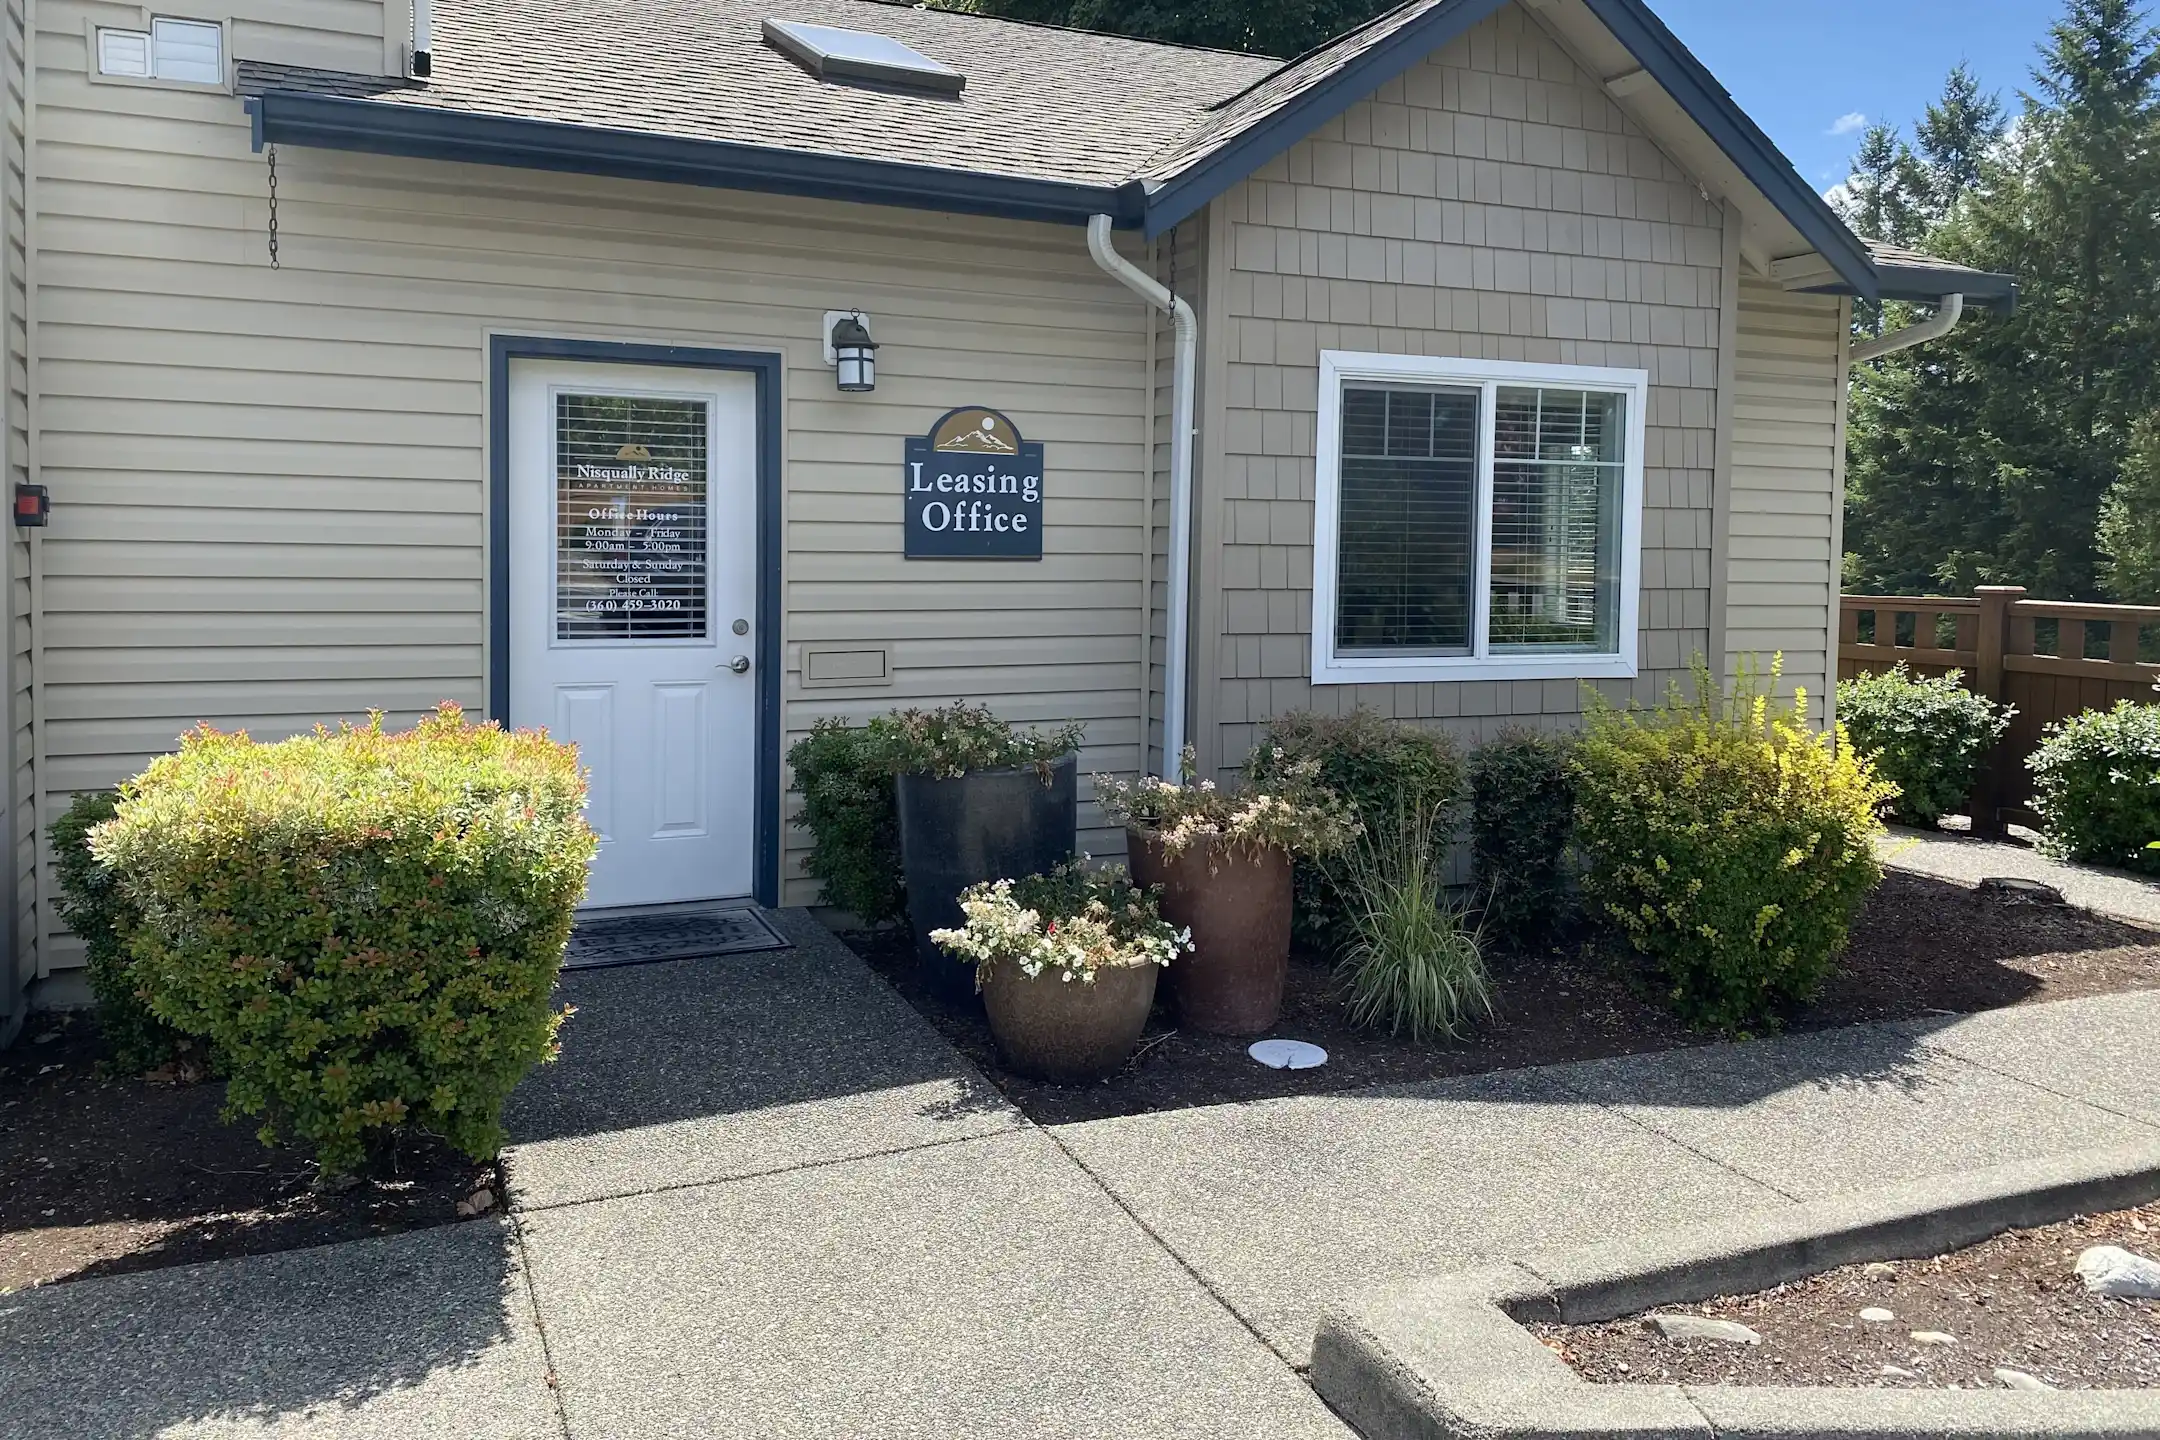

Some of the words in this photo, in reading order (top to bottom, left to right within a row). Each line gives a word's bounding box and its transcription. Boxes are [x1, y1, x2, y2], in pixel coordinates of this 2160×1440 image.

[576, 464, 645, 483] Nisqually
[647, 466, 690, 484] Ridge
[910, 462, 1039, 503] Leasing
[588, 507, 634, 520] Office
[635, 508, 679, 521] Hours
[922, 500, 1028, 532] Office
[585, 526, 632, 538] Monday
[650, 527, 681, 540] Friday
[585, 540, 625, 551] 9:00am
[642, 541, 681, 552] 5:00pm
[582, 558, 630, 571] Saturday
[631, 560, 641, 569] &
[645, 559, 684, 572] Sunday
[616, 573, 651, 584] Closed
[609, 588, 638, 598] Please
[585, 600, 618, 612] (360)
[577, 924, 746, 947] ELCOME
